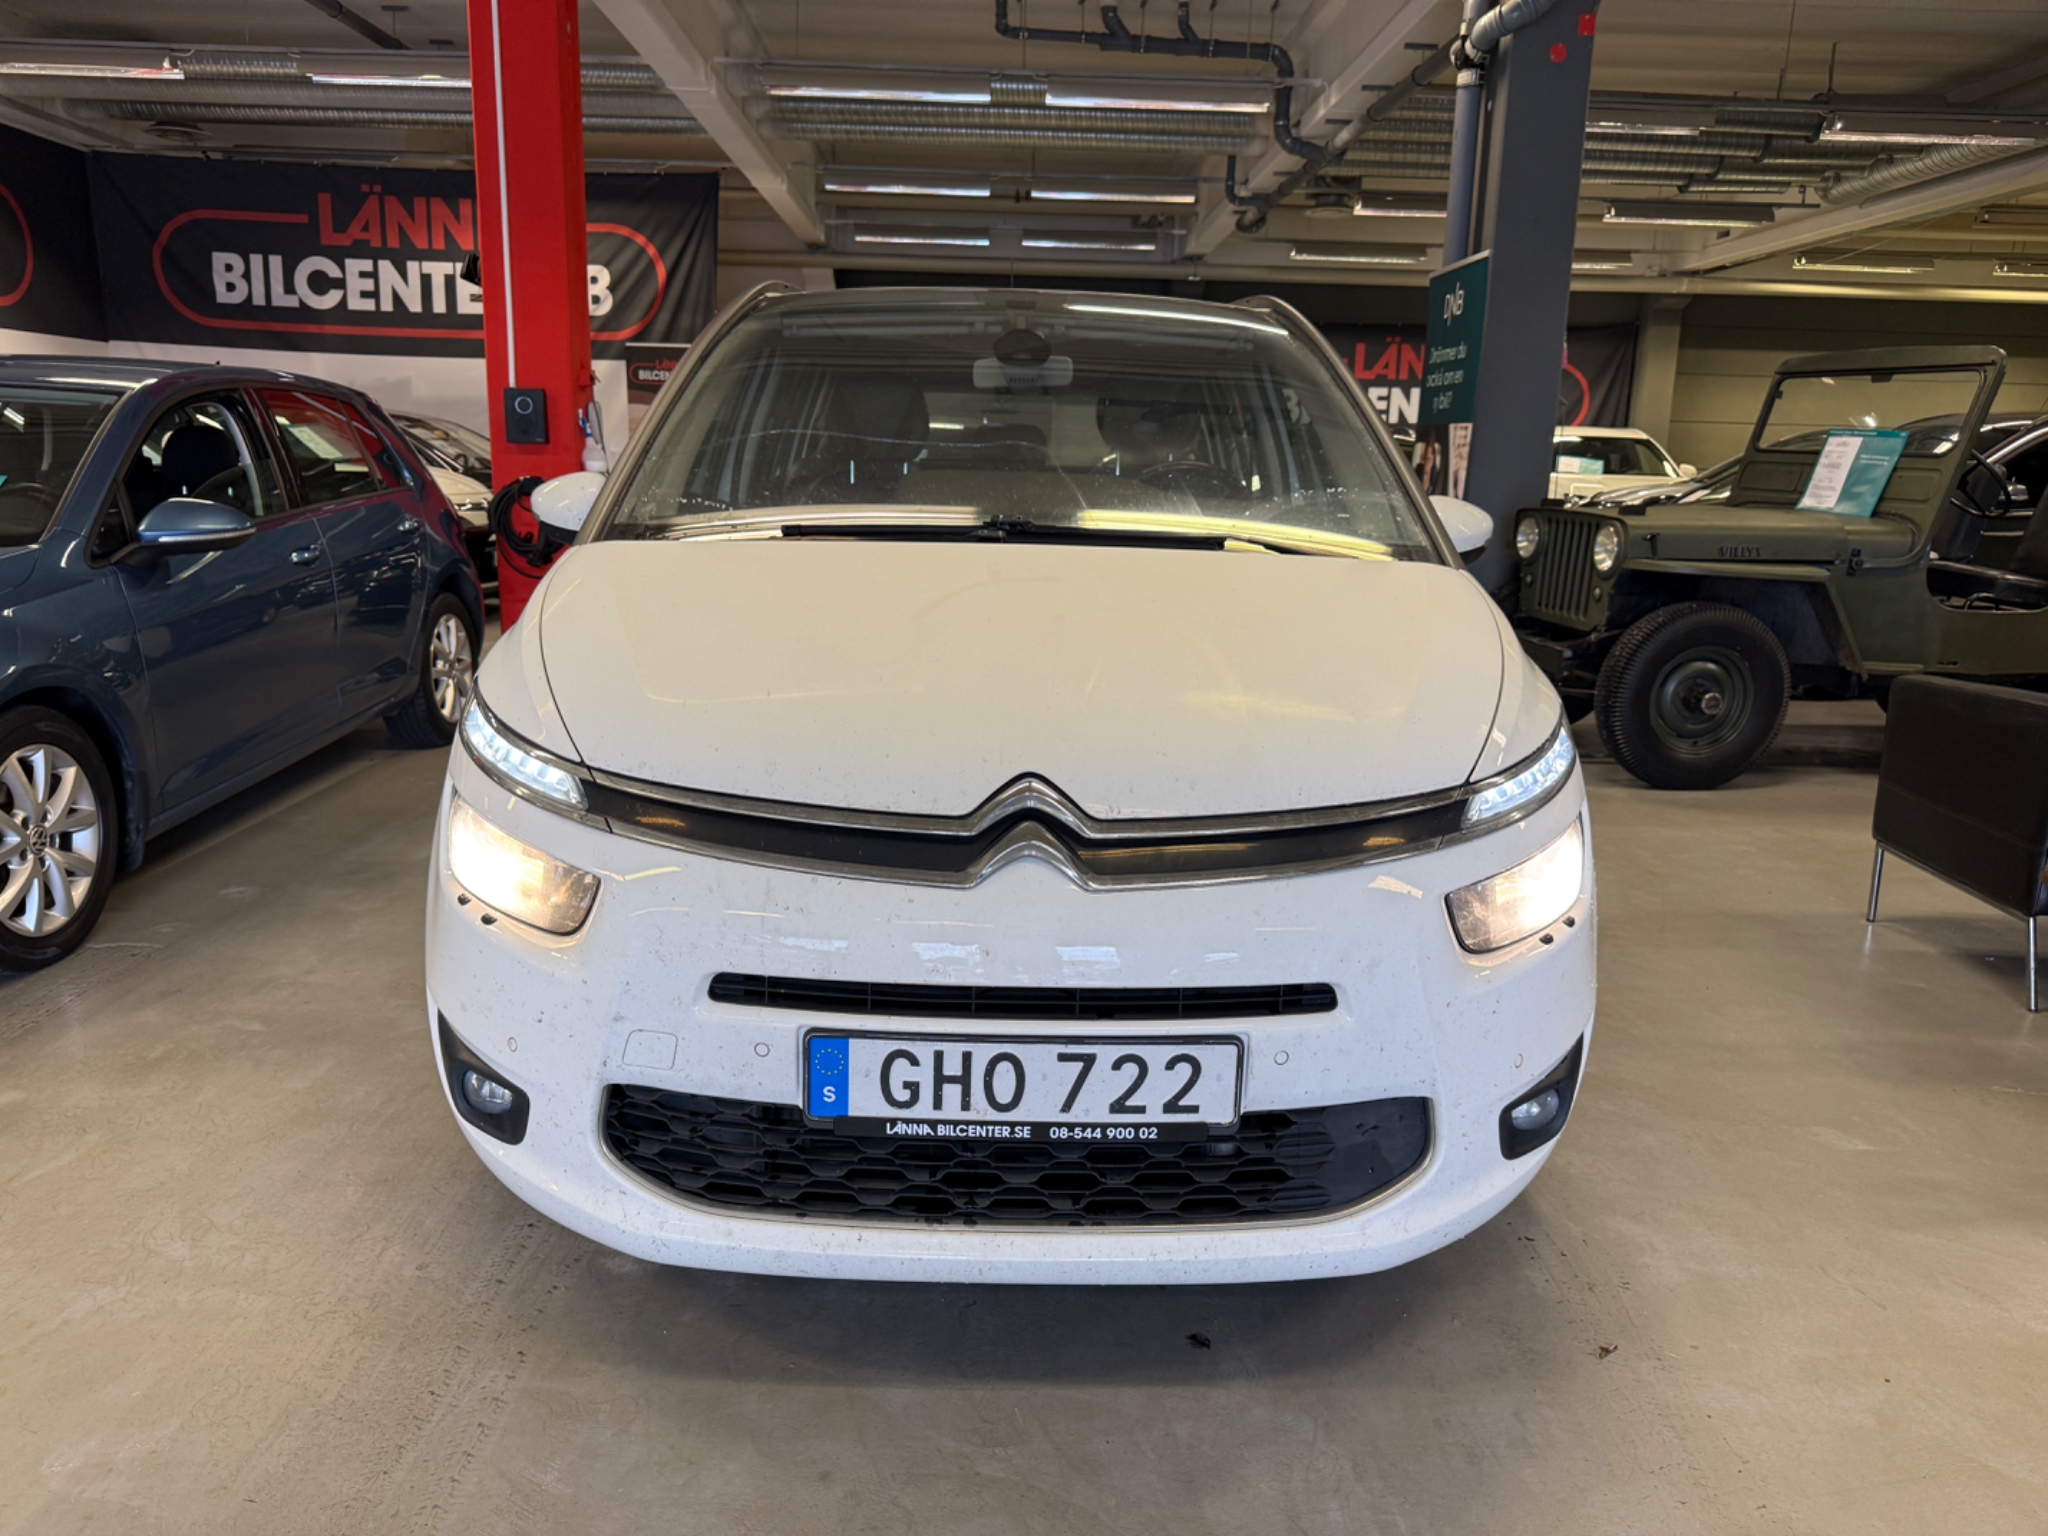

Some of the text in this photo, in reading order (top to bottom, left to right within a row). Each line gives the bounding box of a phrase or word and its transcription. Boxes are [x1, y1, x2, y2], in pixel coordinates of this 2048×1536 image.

[317, 184, 476, 251] LÄNN
[211, 251, 614, 316] BILCENTE B
[1443, 282, 1465, 326] DNB
[1354, 336, 1426, 380] LÄN
[823, 1086, 836, 1102] S
[880, 1048, 1202, 1114] GHO 722
[886, 1121, 1158, 1139] LÄNNA BILCENTER.SE 08-544 900 02
